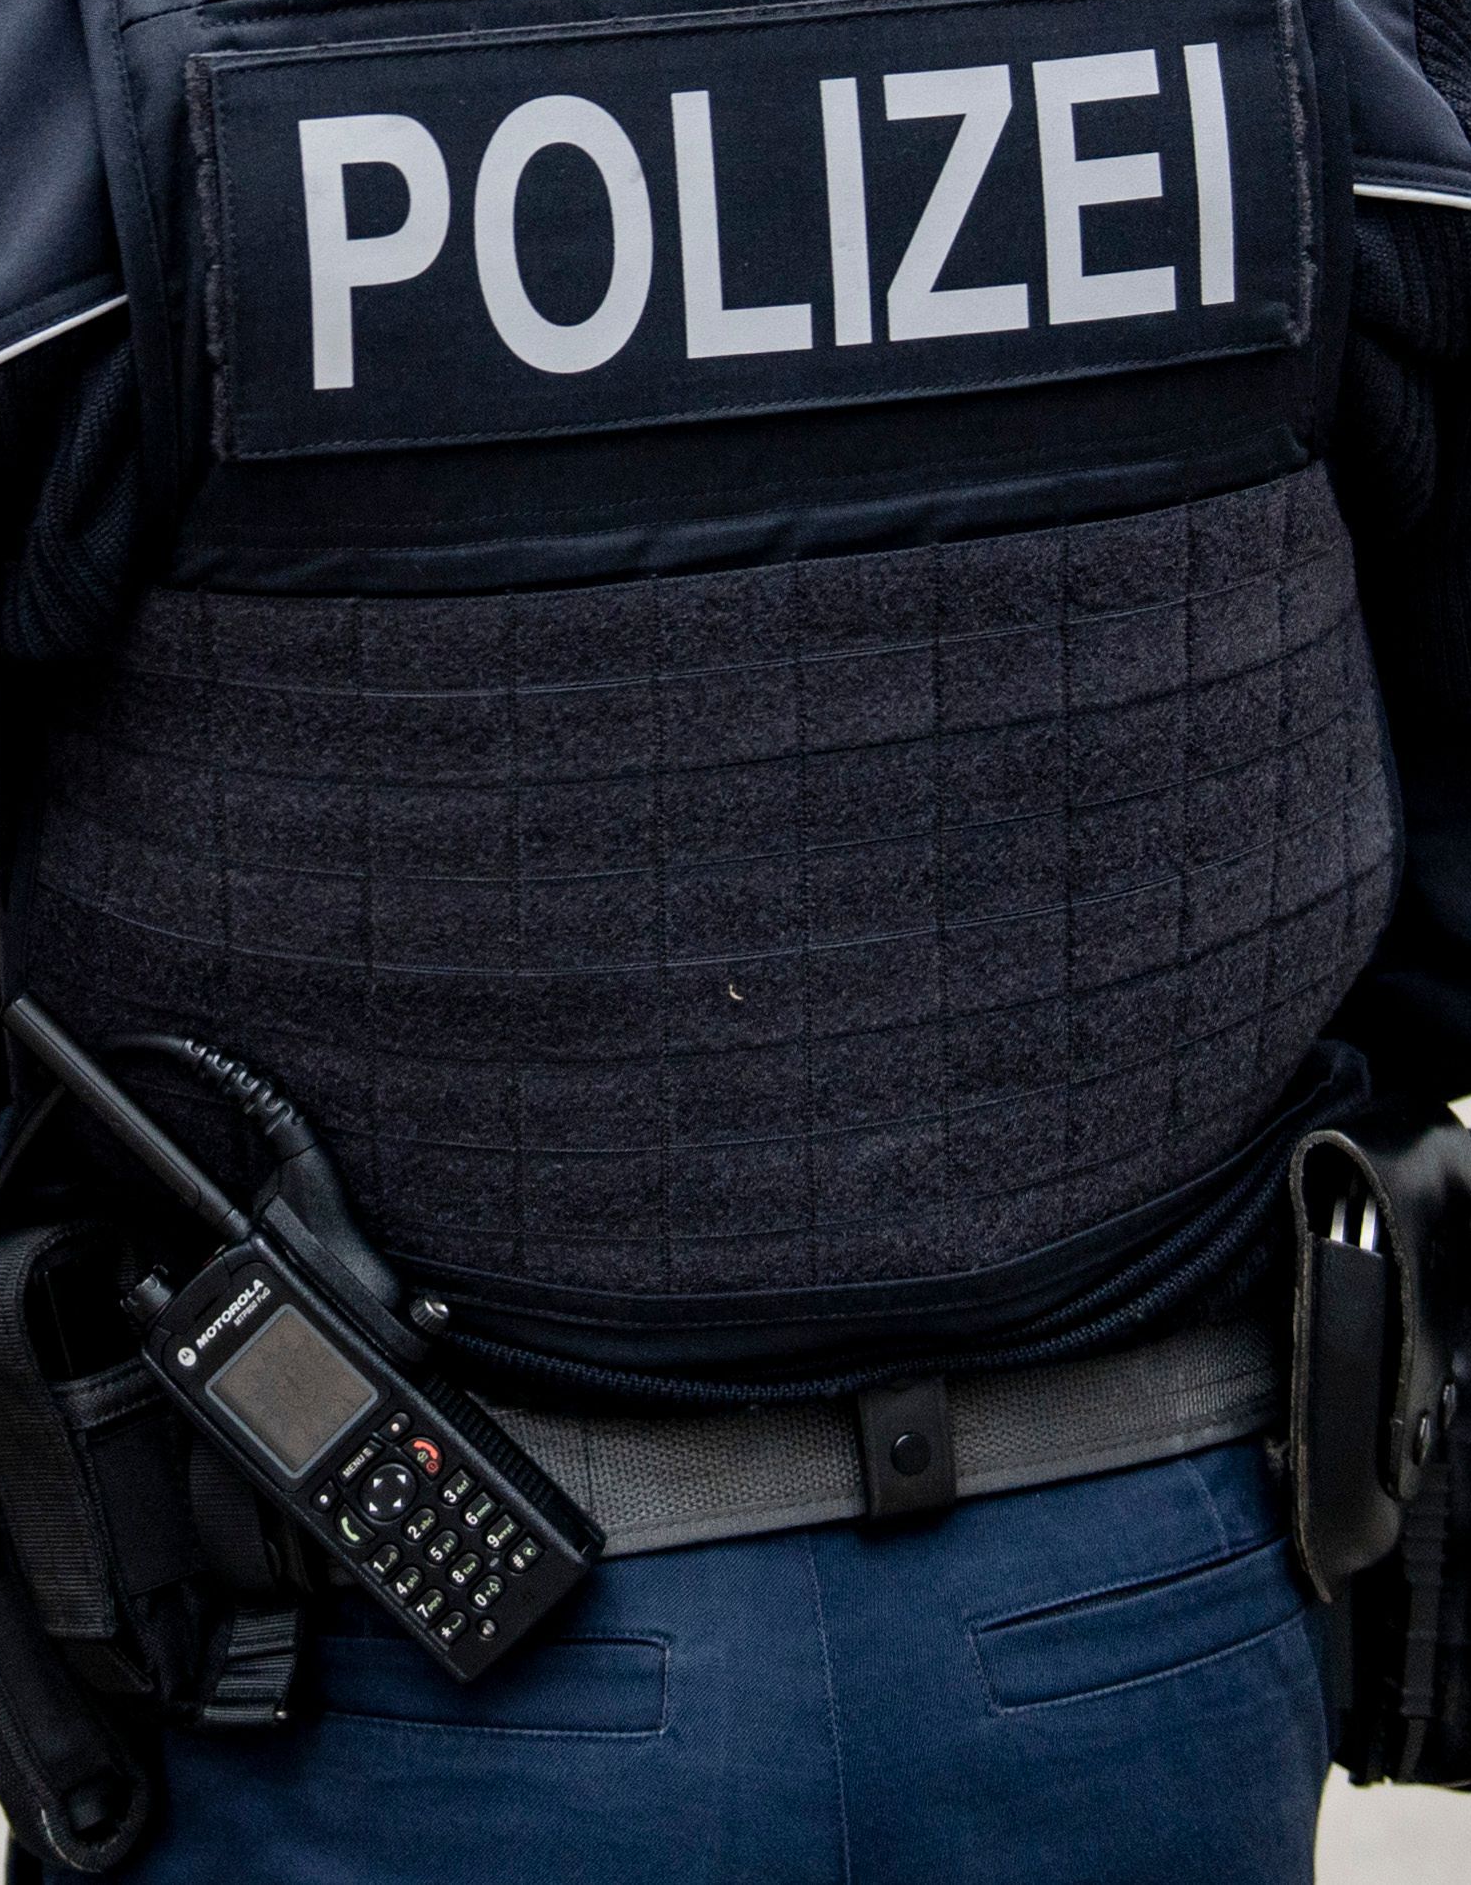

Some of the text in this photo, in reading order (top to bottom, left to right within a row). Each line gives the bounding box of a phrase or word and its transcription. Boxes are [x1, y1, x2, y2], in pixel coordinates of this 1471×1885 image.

[298, 41, 1236, 390] POLIZEI
[195, 1278, 265, 1350] MOTOROLA
[443, 1489, 457, 1503] 3
[465, 1511, 478, 1525] 6
[407, 1525, 421, 1539] 2
[487, 1534, 499, 1548] 9
[430, 1546, 443, 1560] 5
[373, 1561, 385, 1572] 1
[452, 1570, 465, 1583] 8
[396, 1581, 408, 1594] 4
[474, 1593, 487, 1606] 0
[416, 1603, 428, 1618] 7
